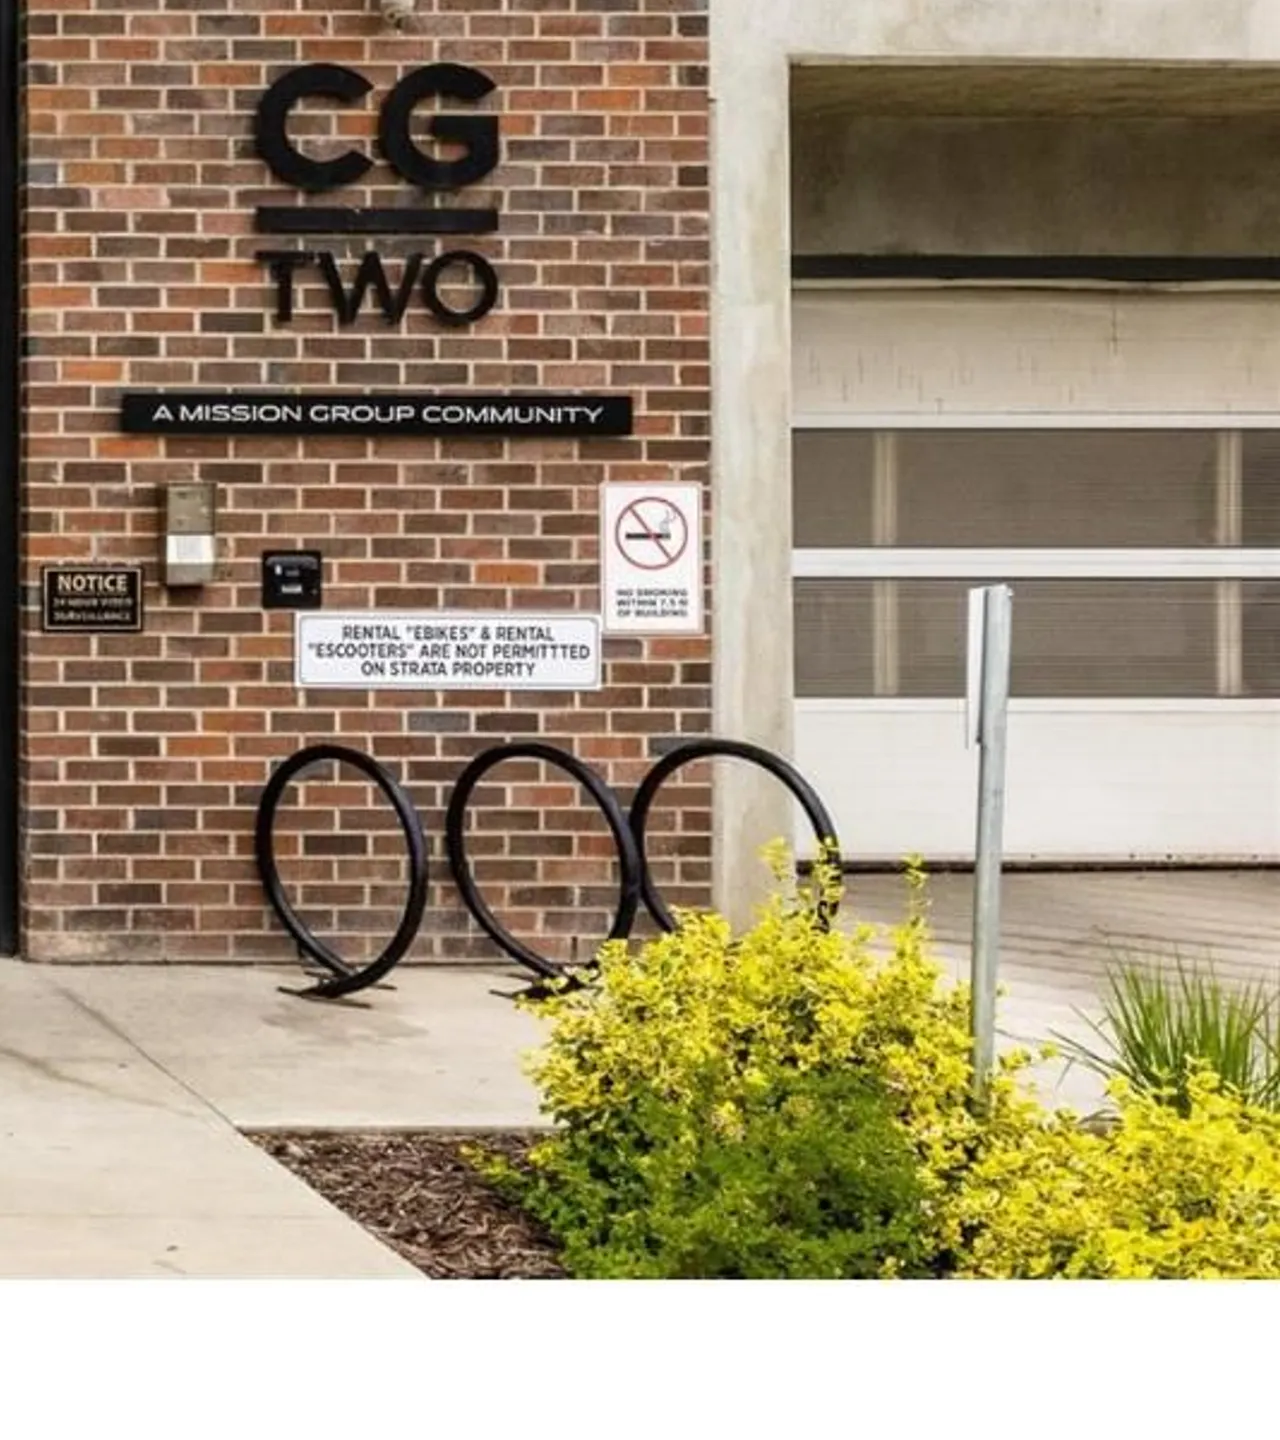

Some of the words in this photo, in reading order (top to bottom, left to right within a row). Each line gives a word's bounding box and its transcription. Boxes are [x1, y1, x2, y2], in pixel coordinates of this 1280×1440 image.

[255, 62, 499, 194] CG
[255, 250, 499, 325] TWO
[152, 405, 174, 423] A
[179, 405, 302, 423] MISSION
[310, 405, 416, 423] GROUP
[422, 405, 603, 425] COMMUNITY
[58, 574, 128, 591] NOTICE
[342, 625, 401, 640] RENTAL
[406, 625, 476, 640] "EBIKES"
[480, 626, 491, 640] &
[495, 626, 554, 641] RENTAL
[308, 643, 415, 658] "ESCOOTERS"
[419, 643, 451, 658] ARE
[455, 643, 487, 658] NOT
[361, 661, 385, 676] ON
[390, 661, 448, 676] STRATA
[452, 661, 536, 676] PROPERTY
